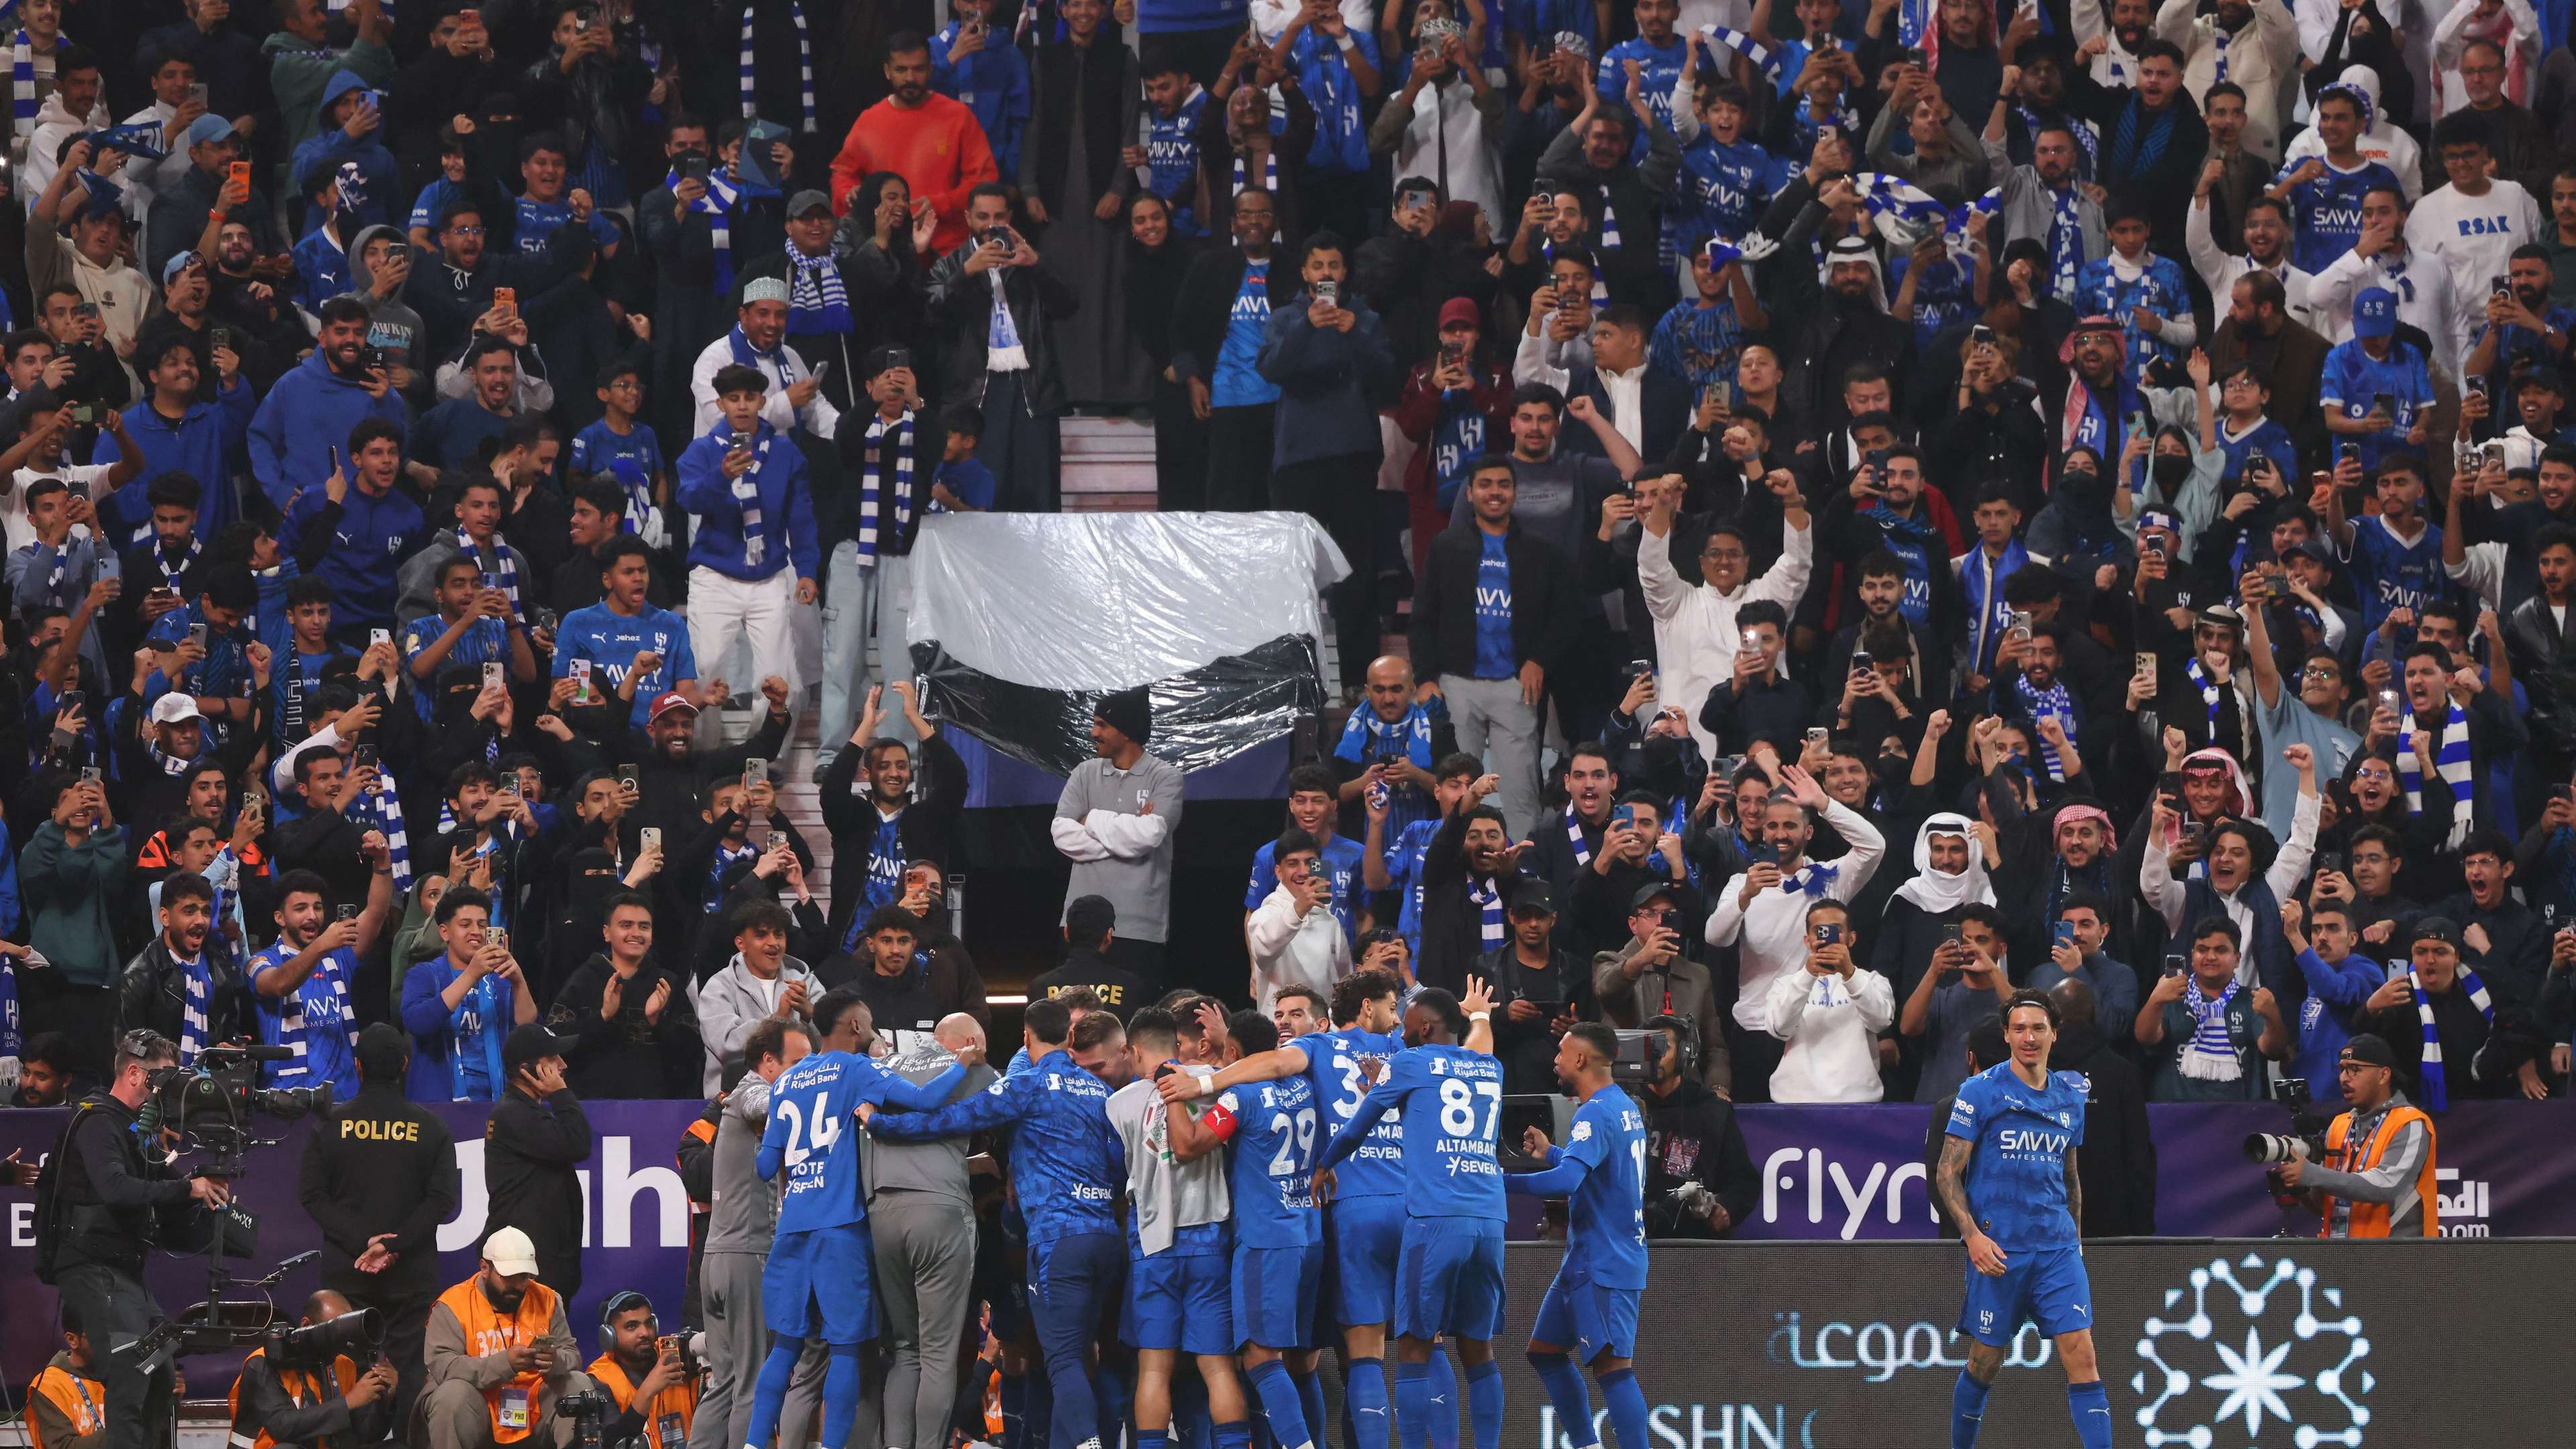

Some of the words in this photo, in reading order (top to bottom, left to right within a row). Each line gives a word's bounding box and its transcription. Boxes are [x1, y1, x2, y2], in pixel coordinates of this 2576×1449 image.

[2457, 215, 2512, 236] RSAK
[614, 633, 641, 642] jahez
[1047, 984, 1124, 1005] PCE
[900, 1063, 926, 1073] Riyad
[929, 1059, 953, 1069] Bank
[1454, 1068, 1479, 1077] Riyad
[1479, 1069, 1497, 1079] Bank
[791, 1077, 816, 1089] Riyad
[816, 1073, 839, 1084] Bank
[1067, 1085, 1090, 1096] Riyad
[1332, 1054, 1401, 1123] 3
[1440, 1078, 1501, 1140] 87
[341, 1119, 419, 1142] POLICE
[776, 1091, 841, 1167] 24
[1269, 1108, 1316, 1175] 29
[2000, 1130, 2072, 1153] SAVVY
[1359, 1146, 1401, 1159] SEVEN
[1460, 1160, 1497, 1175] SEVEN
